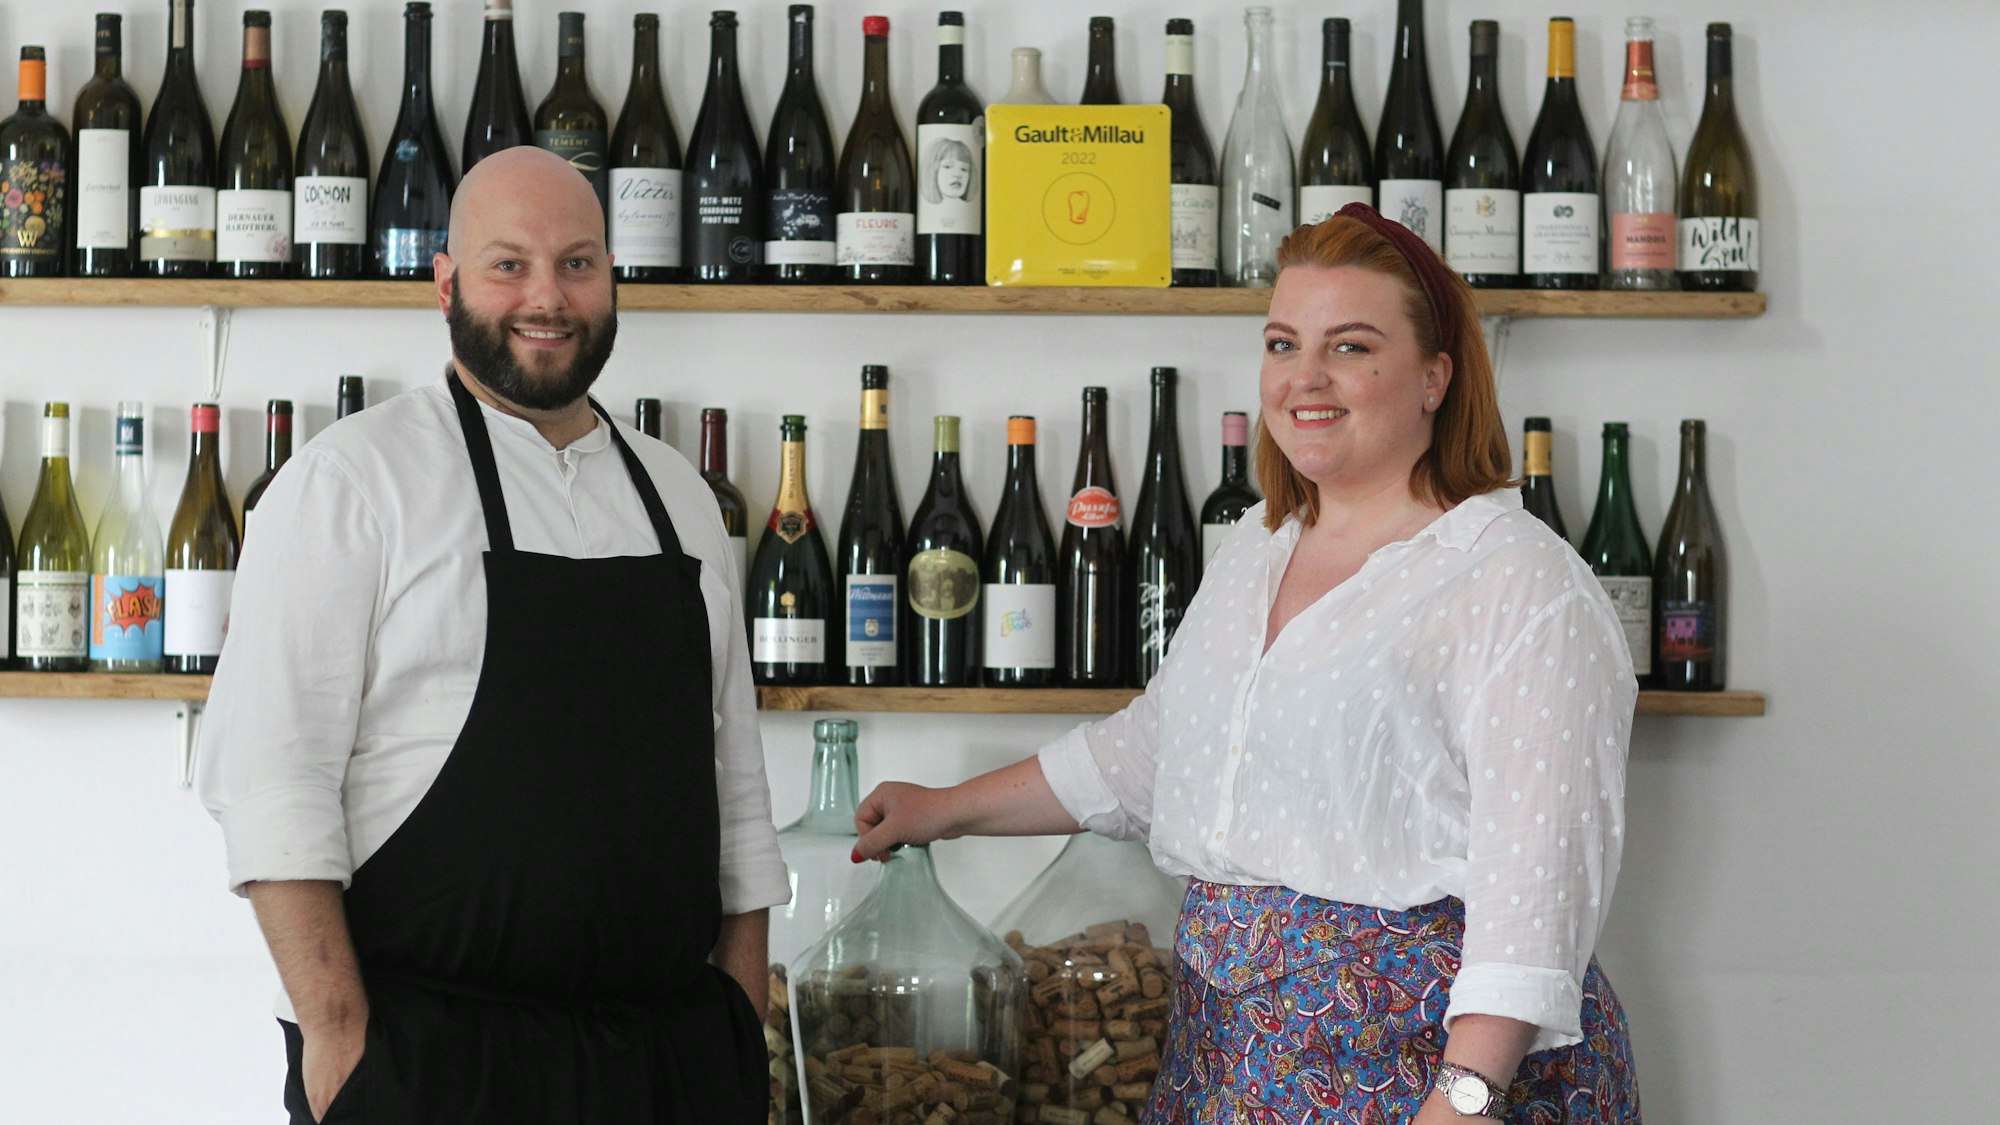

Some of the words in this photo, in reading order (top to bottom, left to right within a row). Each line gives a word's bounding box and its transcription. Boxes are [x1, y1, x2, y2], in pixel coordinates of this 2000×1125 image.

[1014, 125, 1145, 145] Gault&Millau
[549, 138, 589, 147] TEMENT
[1061, 152, 1097, 165] 2022
[305, 185, 350, 205] COCHON
[699, 206, 742, 215] CHARDONNAY
[228, 213, 275, 222] DERNAUER
[702, 215, 722, 225] PINOT
[723, 215, 740, 225] NOIR
[855, 218, 899, 229] FLEURIE
[1692, 217, 1740, 248] Wild
[107, 595, 162, 623] FLASH
